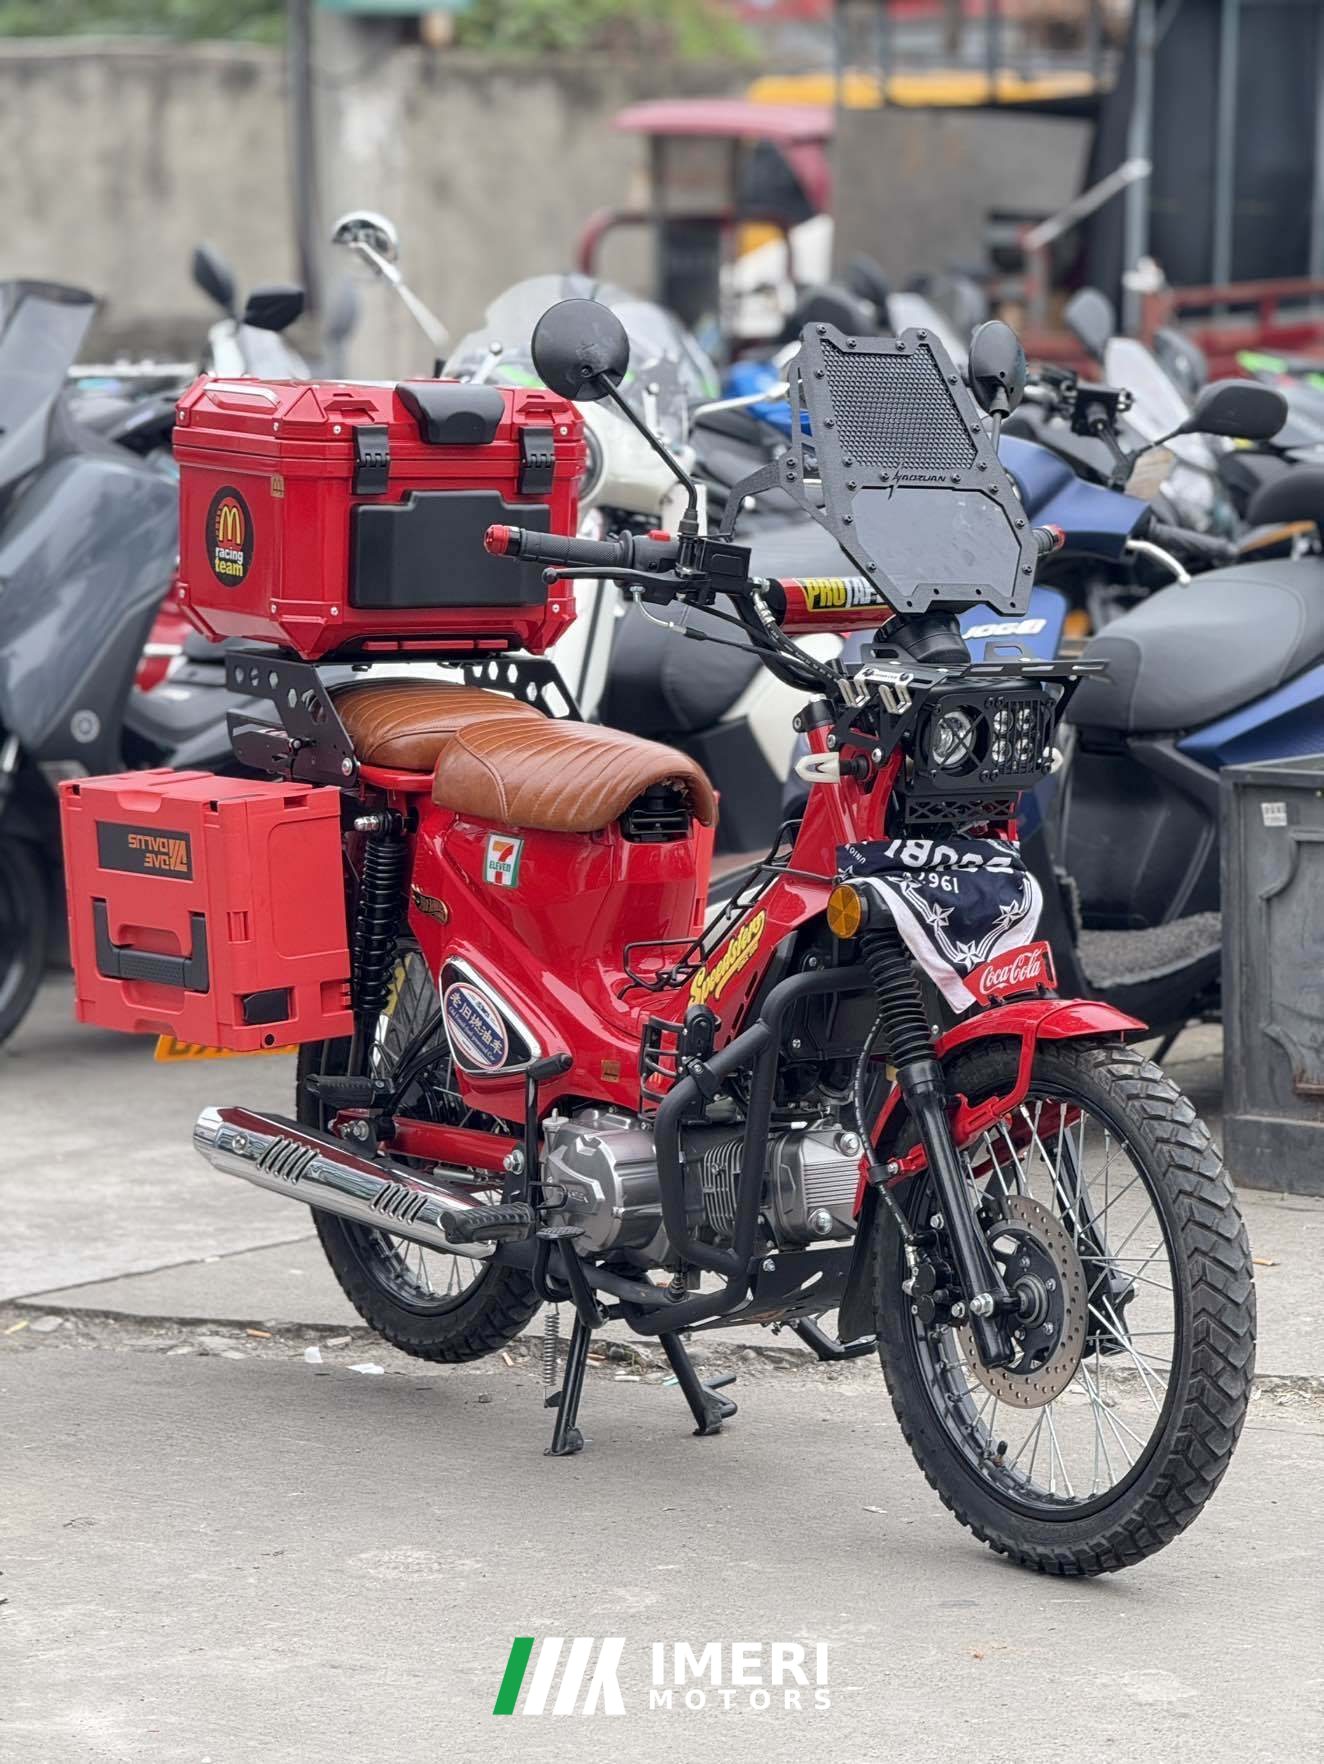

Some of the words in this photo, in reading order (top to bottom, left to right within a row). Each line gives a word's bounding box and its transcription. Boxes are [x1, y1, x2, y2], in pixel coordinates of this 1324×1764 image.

[215, 545, 244, 565] racing
[214, 557, 243, 577] team
[979, 948, 1042, 995] Coca-Cola
